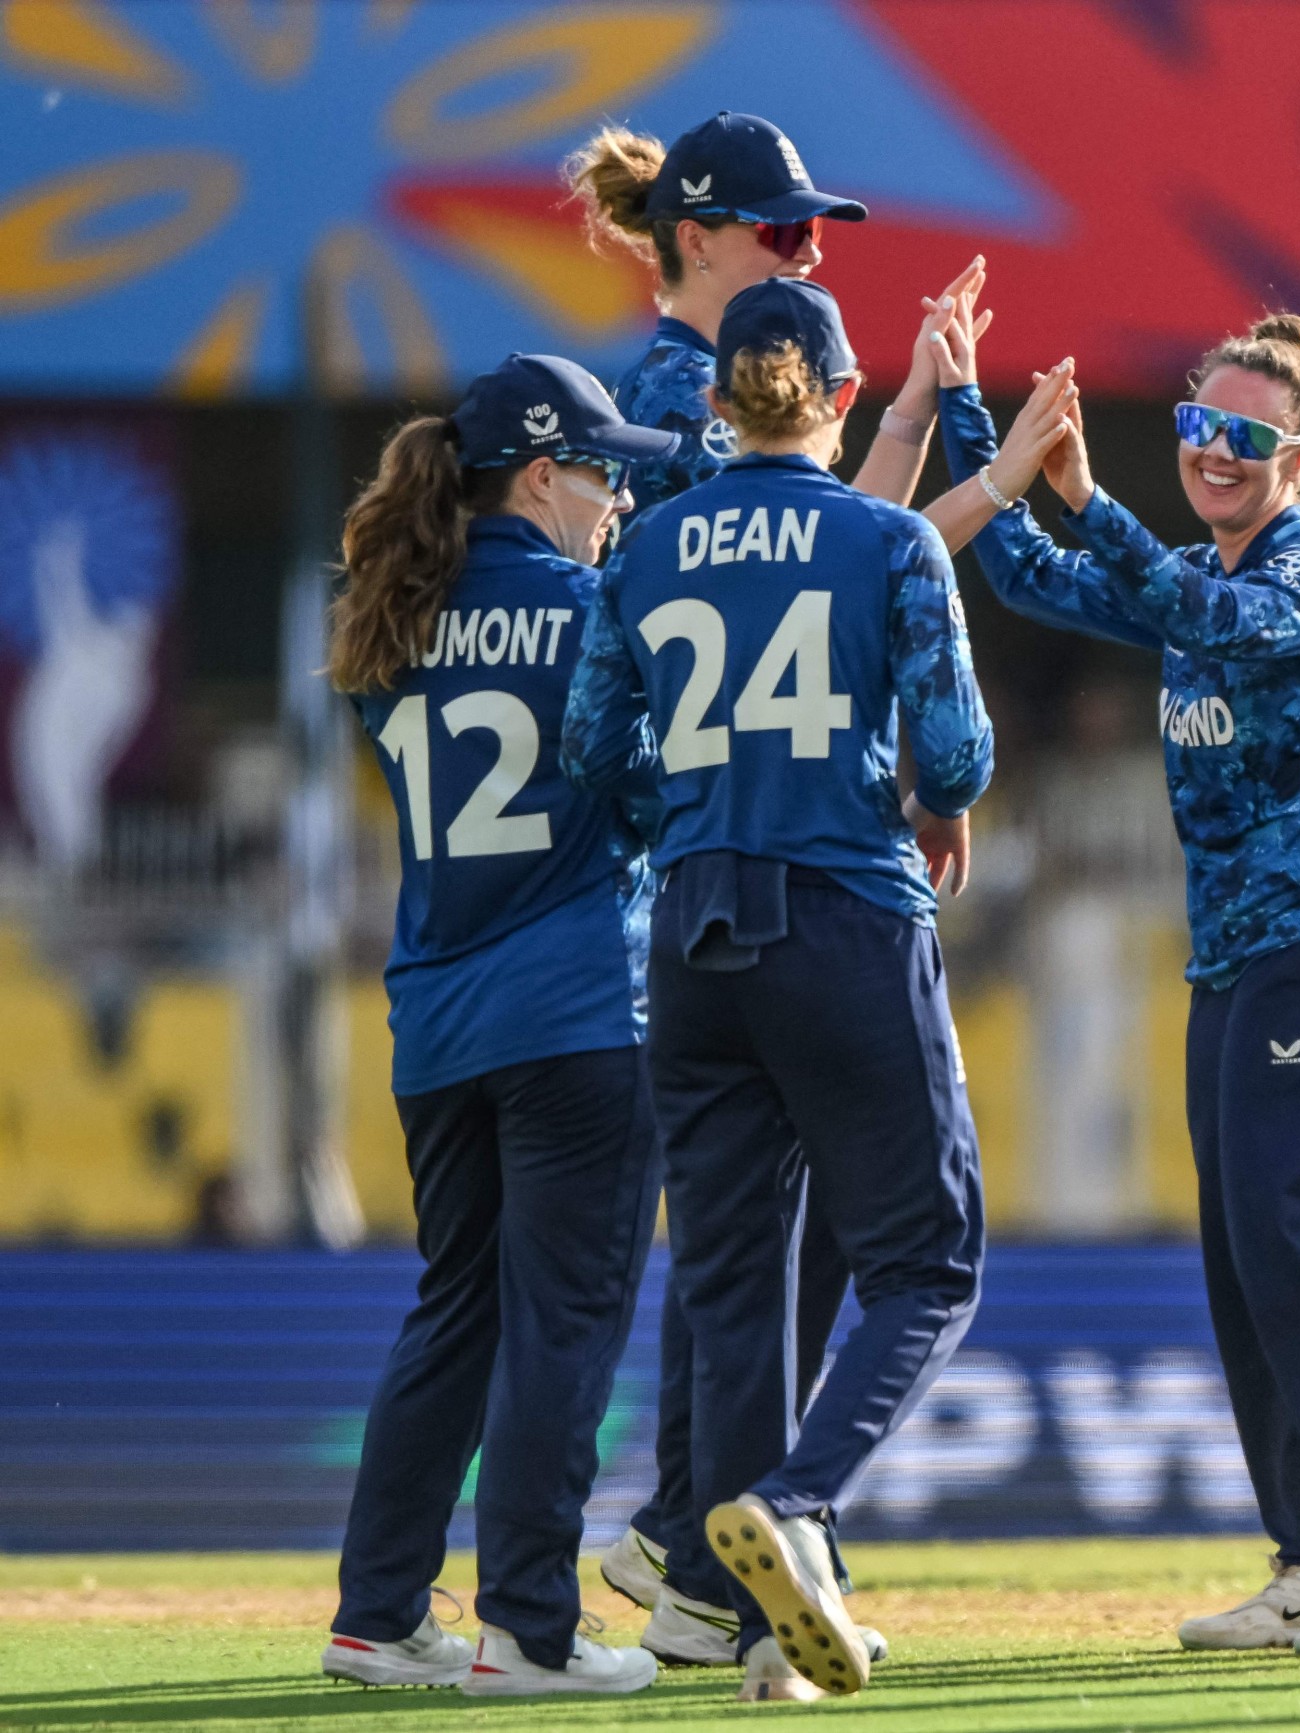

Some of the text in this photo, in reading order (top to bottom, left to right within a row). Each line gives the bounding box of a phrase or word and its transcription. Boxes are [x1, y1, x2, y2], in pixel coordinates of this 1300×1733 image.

[525, 402, 552, 420] 100
[678, 507, 822, 572] DEAN
[409, 607, 573, 669] UMONT
[637, 589, 852, 775] 24
[377, 690, 553, 861] 12
